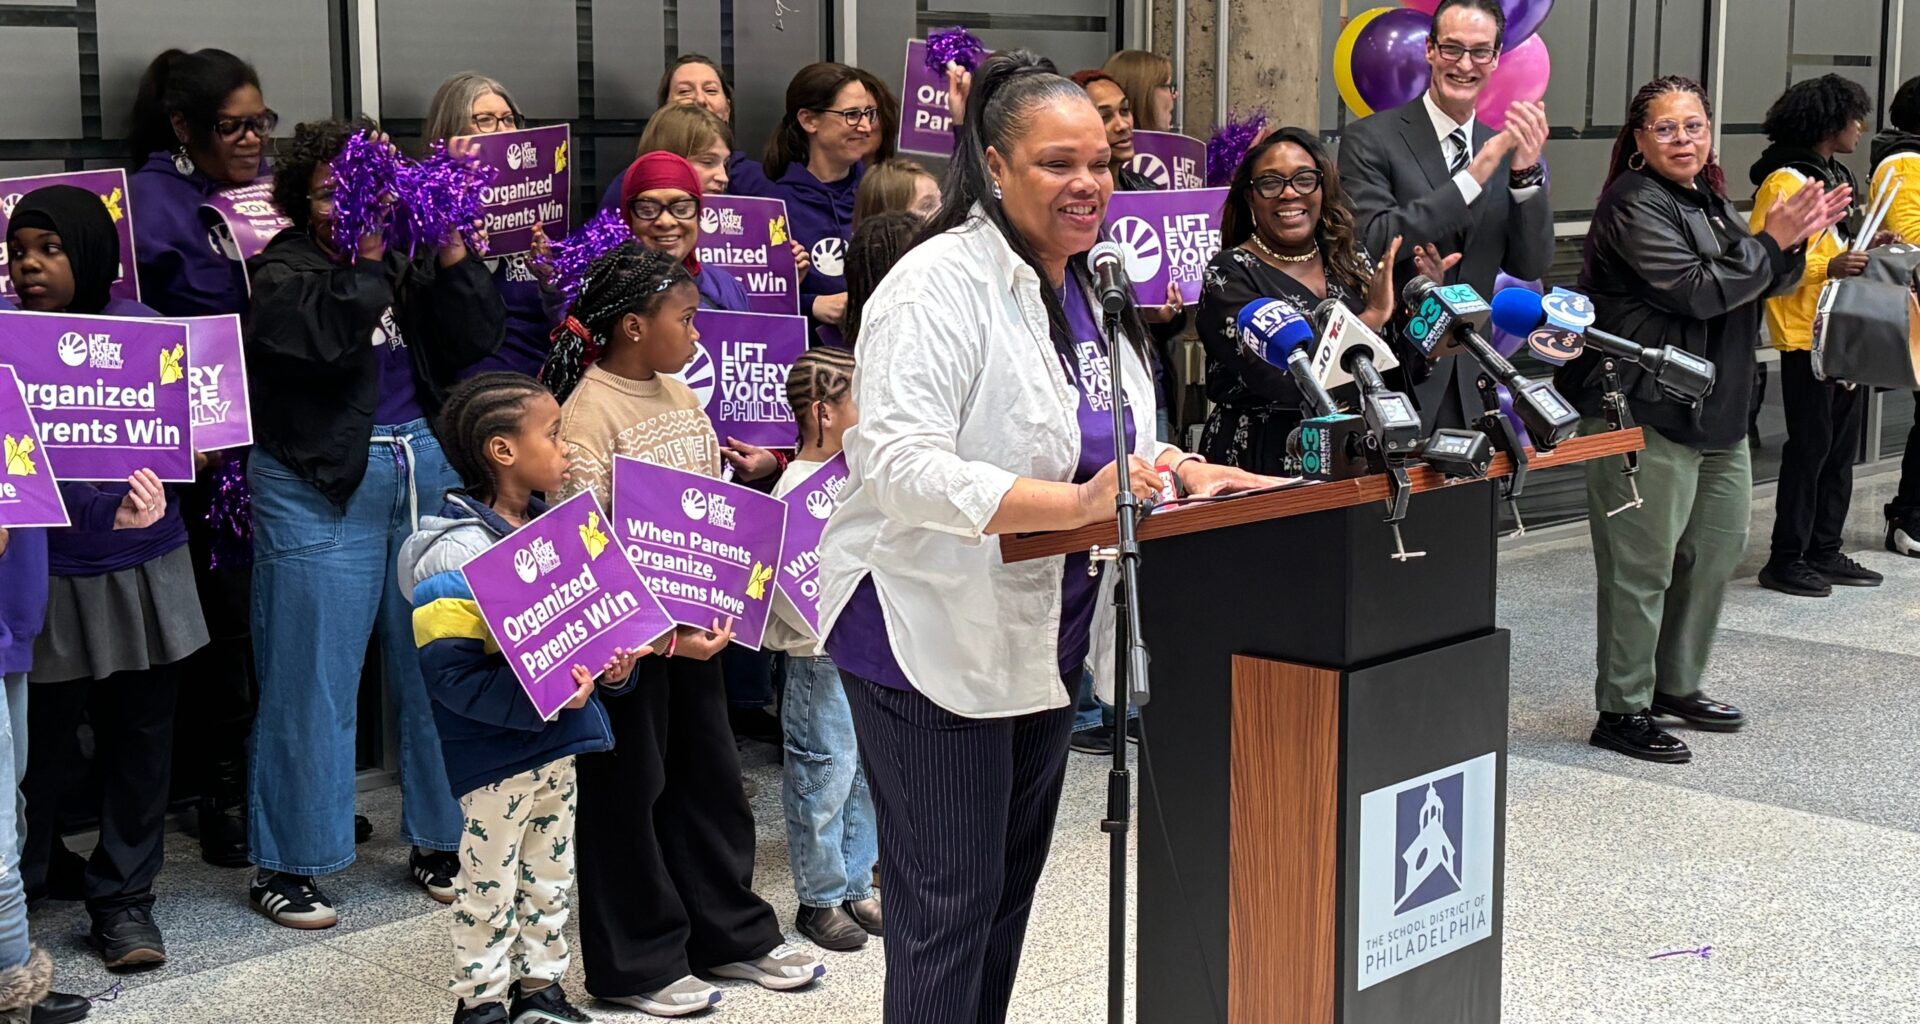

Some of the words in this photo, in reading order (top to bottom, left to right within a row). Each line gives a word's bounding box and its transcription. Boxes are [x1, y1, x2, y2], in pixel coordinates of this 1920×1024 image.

[1173, 156, 1196, 174] LIFT
[479, 173, 552, 206] Organized
[239, 204, 269, 213] JOY
[484, 207, 536, 232] Parents
[537, 199, 563, 221] Win
[719, 208, 734, 217] LIFT
[1163, 213, 1210, 233] LIFT
[1164, 229, 1222, 250] EVER
[695, 242, 768, 264] anized
[1166, 246, 1220, 266] VOIC
[747, 271, 787, 292] Win
[1168, 263, 1205, 282] PHI
[1421, 297, 1442, 323] 3
[89, 333, 111, 344] LIFT
[89, 342, 122, 352] EVERY
[89, 350, 121, 360] VOICE
[722, 341, 767, 362] LIFT
[721, 361, 794, 384] EVERY
[720, 381, 788, 403] VOICE
[720, 400, 796, 422] PHILLY
[34, 419, 117, 443] rents
[124, 417, 180, 445] Win
[1302, 427, 1320, 450] 3
[822, 474, 838, 492] LIFT
[708, 492, 727, 505] LIFT
[627, 517, 686, 547] When
[690, 532, 751, 565] Parents
[627, 544, 717, 581] Organize,
[503, 563, 597, 642] Organized
[710, 587, 745, 614] Move
[520, 619, 588, 678] Parents
[583, 589, 639, 630] Win
[1366, 934, 1385, 951] THE
[1388, 919, 1426, 943] SCHOOL
[1430, 900, 1470, 926] DISTRICT
[1474, 894, 1486, 907] OF
[1366, 909, 1487, 974] PHILADELPHIA
